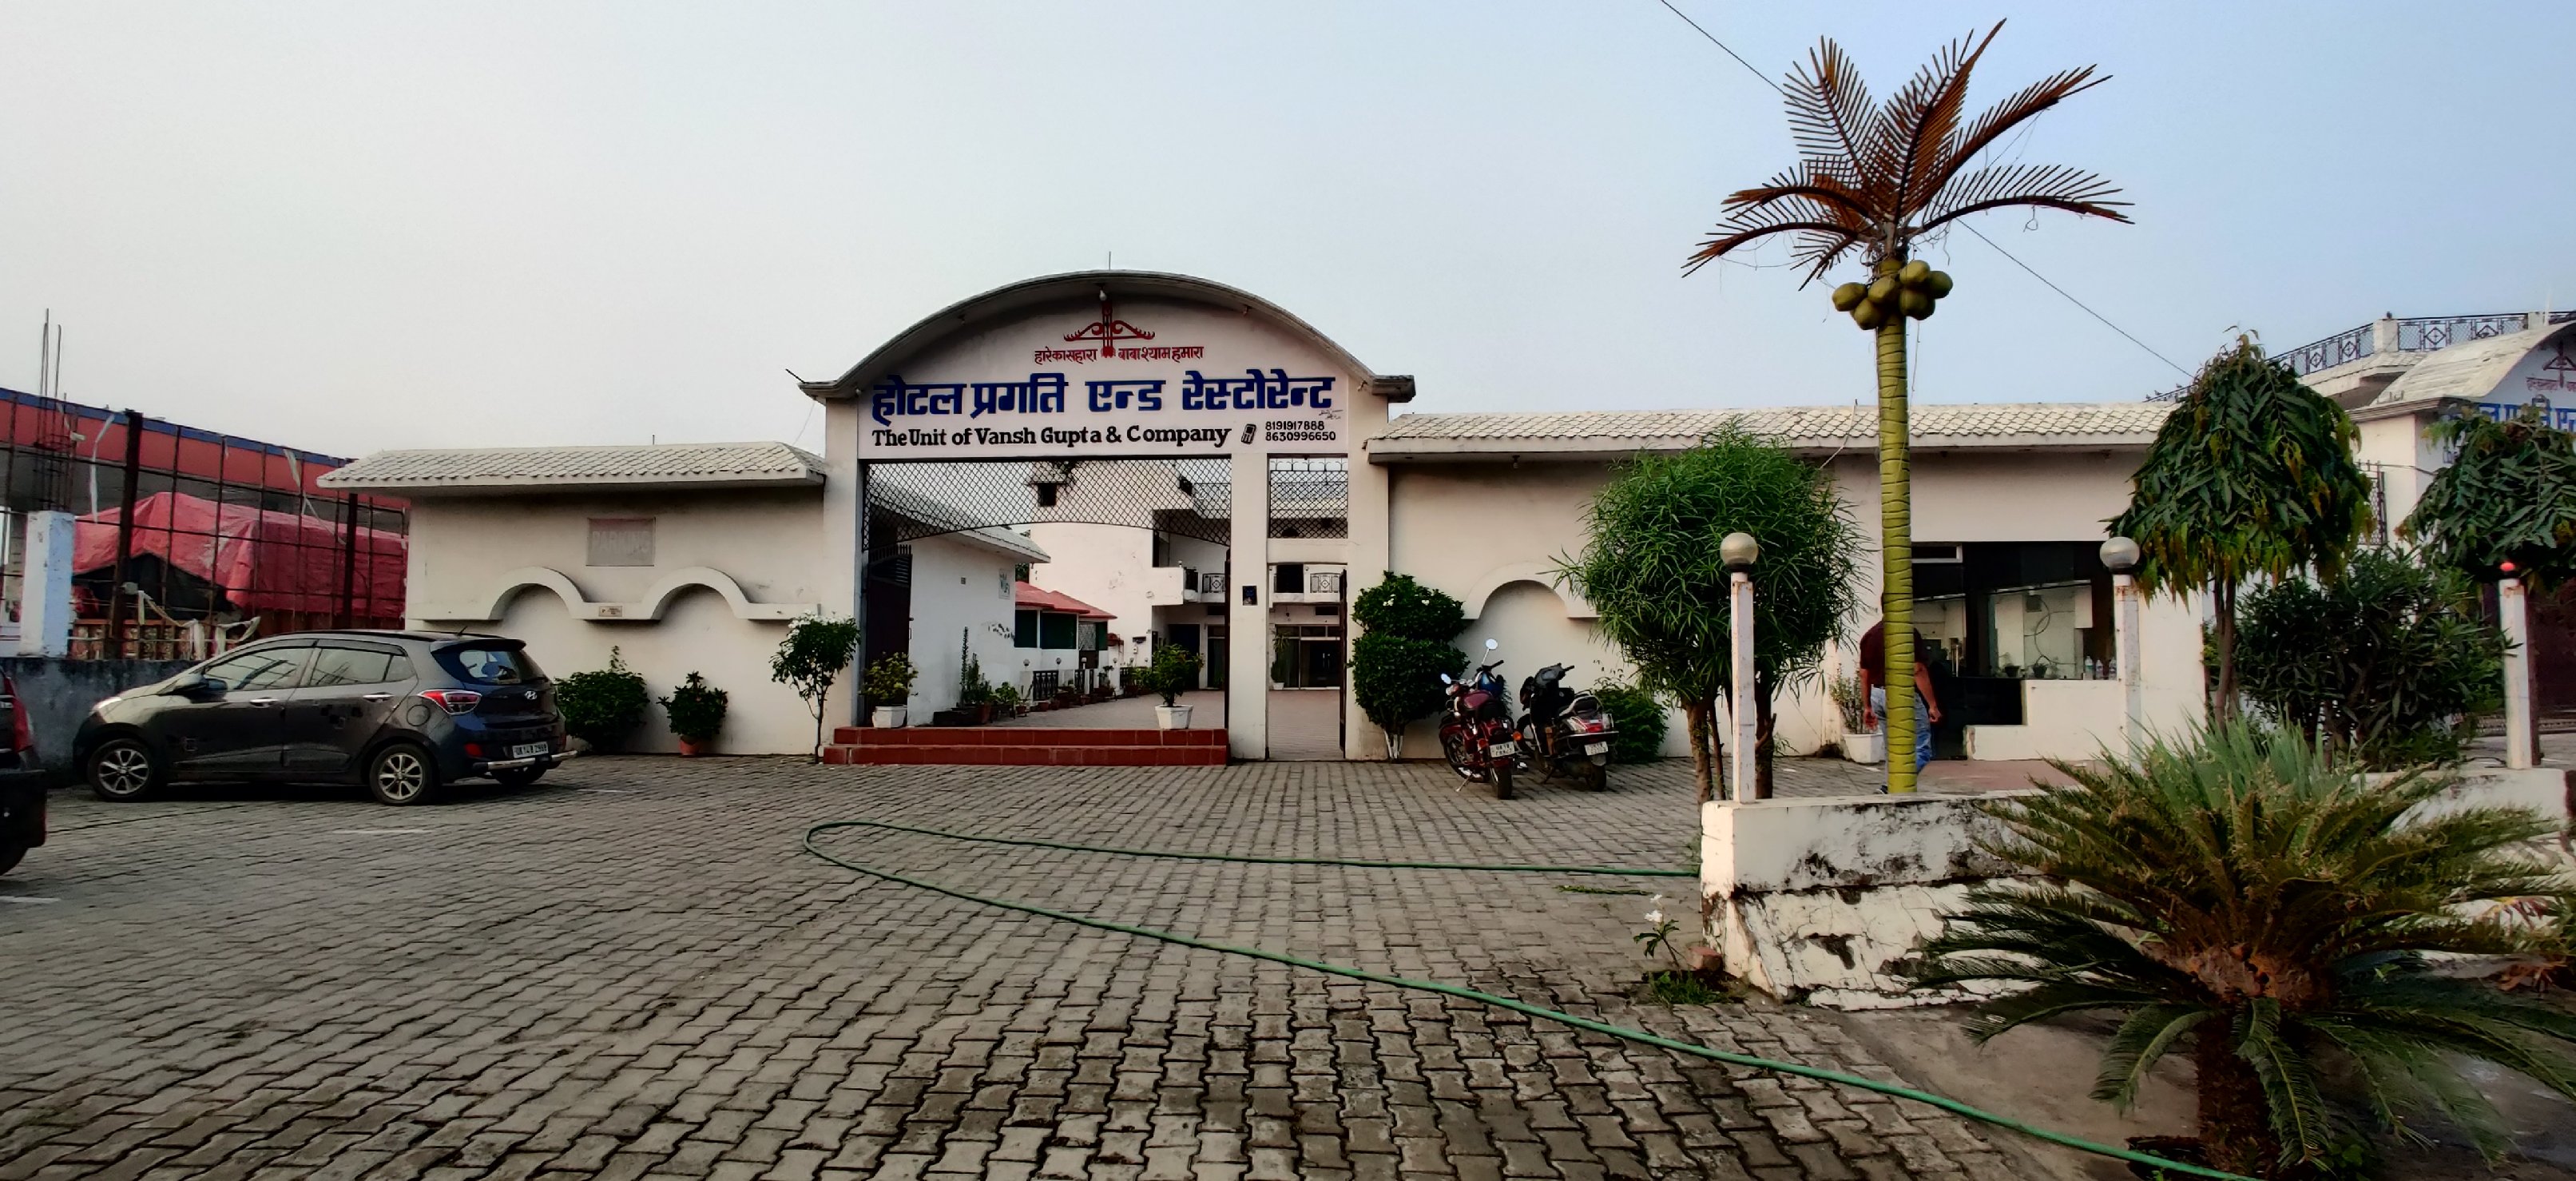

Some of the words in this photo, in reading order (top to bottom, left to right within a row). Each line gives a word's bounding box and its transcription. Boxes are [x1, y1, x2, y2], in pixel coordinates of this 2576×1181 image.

[1118, 348, 1141, 360] बाबा
[1171, 346, 1204, 363] हमारा
[872, 374, 966, 427] होटल
[970, 372, 1069, 420] प्रगति
[1085, 380, 1166, 412] एन्ड
[1182, 368, 1336, 411] रेस्टोरेन्ट
[1265, 420, 1325, 431] 8191917888
[872, 429, 907, 447] The
[908, 429, 947, 446] Unit
[951, 427, 972, 446] of
[974, 427, 1036, 445] Vansh
[1041, 427, 1102, 447] Gupta
[1105, 426, 1122, 443] &
[1126, 424, 1232, 447] Company
[1265, 431, 1336, 441] 8630996650
